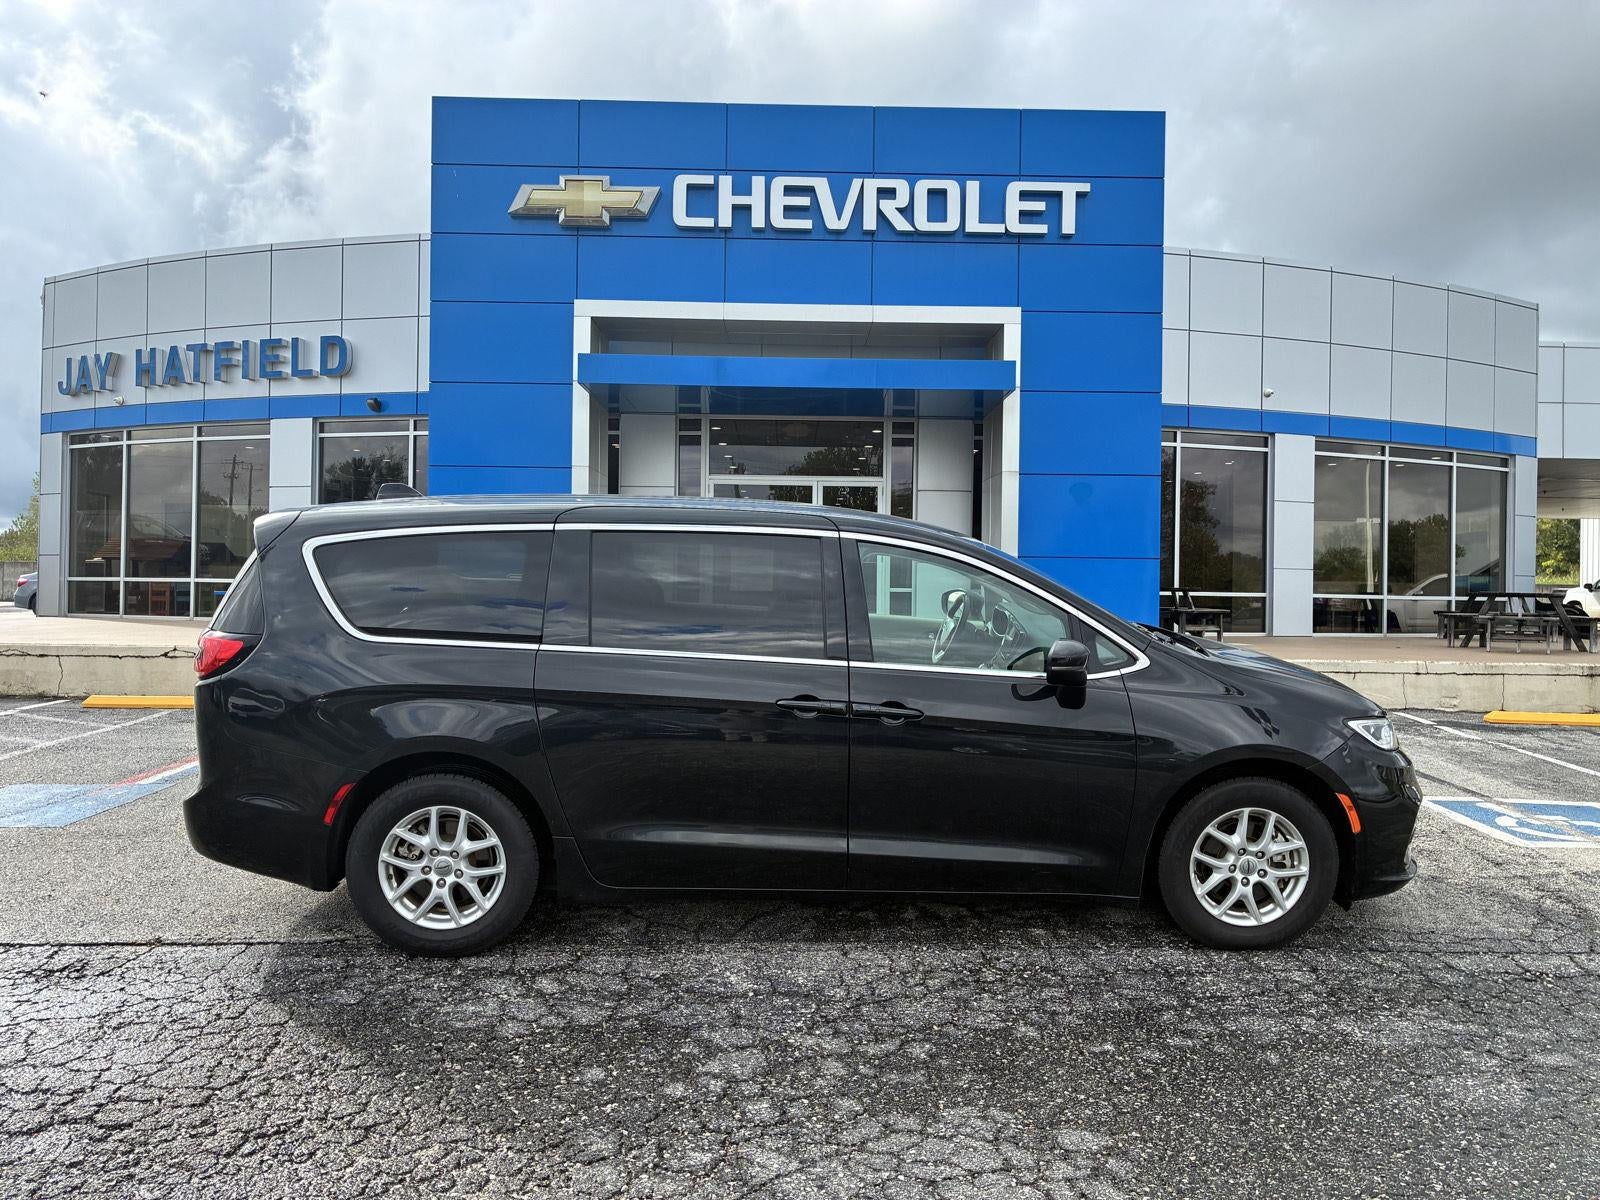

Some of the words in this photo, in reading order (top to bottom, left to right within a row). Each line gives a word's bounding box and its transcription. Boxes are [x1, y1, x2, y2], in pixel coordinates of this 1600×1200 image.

[673, 174, 1091, 237] CHEVROLET
[58, 352, 119, 395] JAY
[135, 335, 352, 387] HATFIELD
